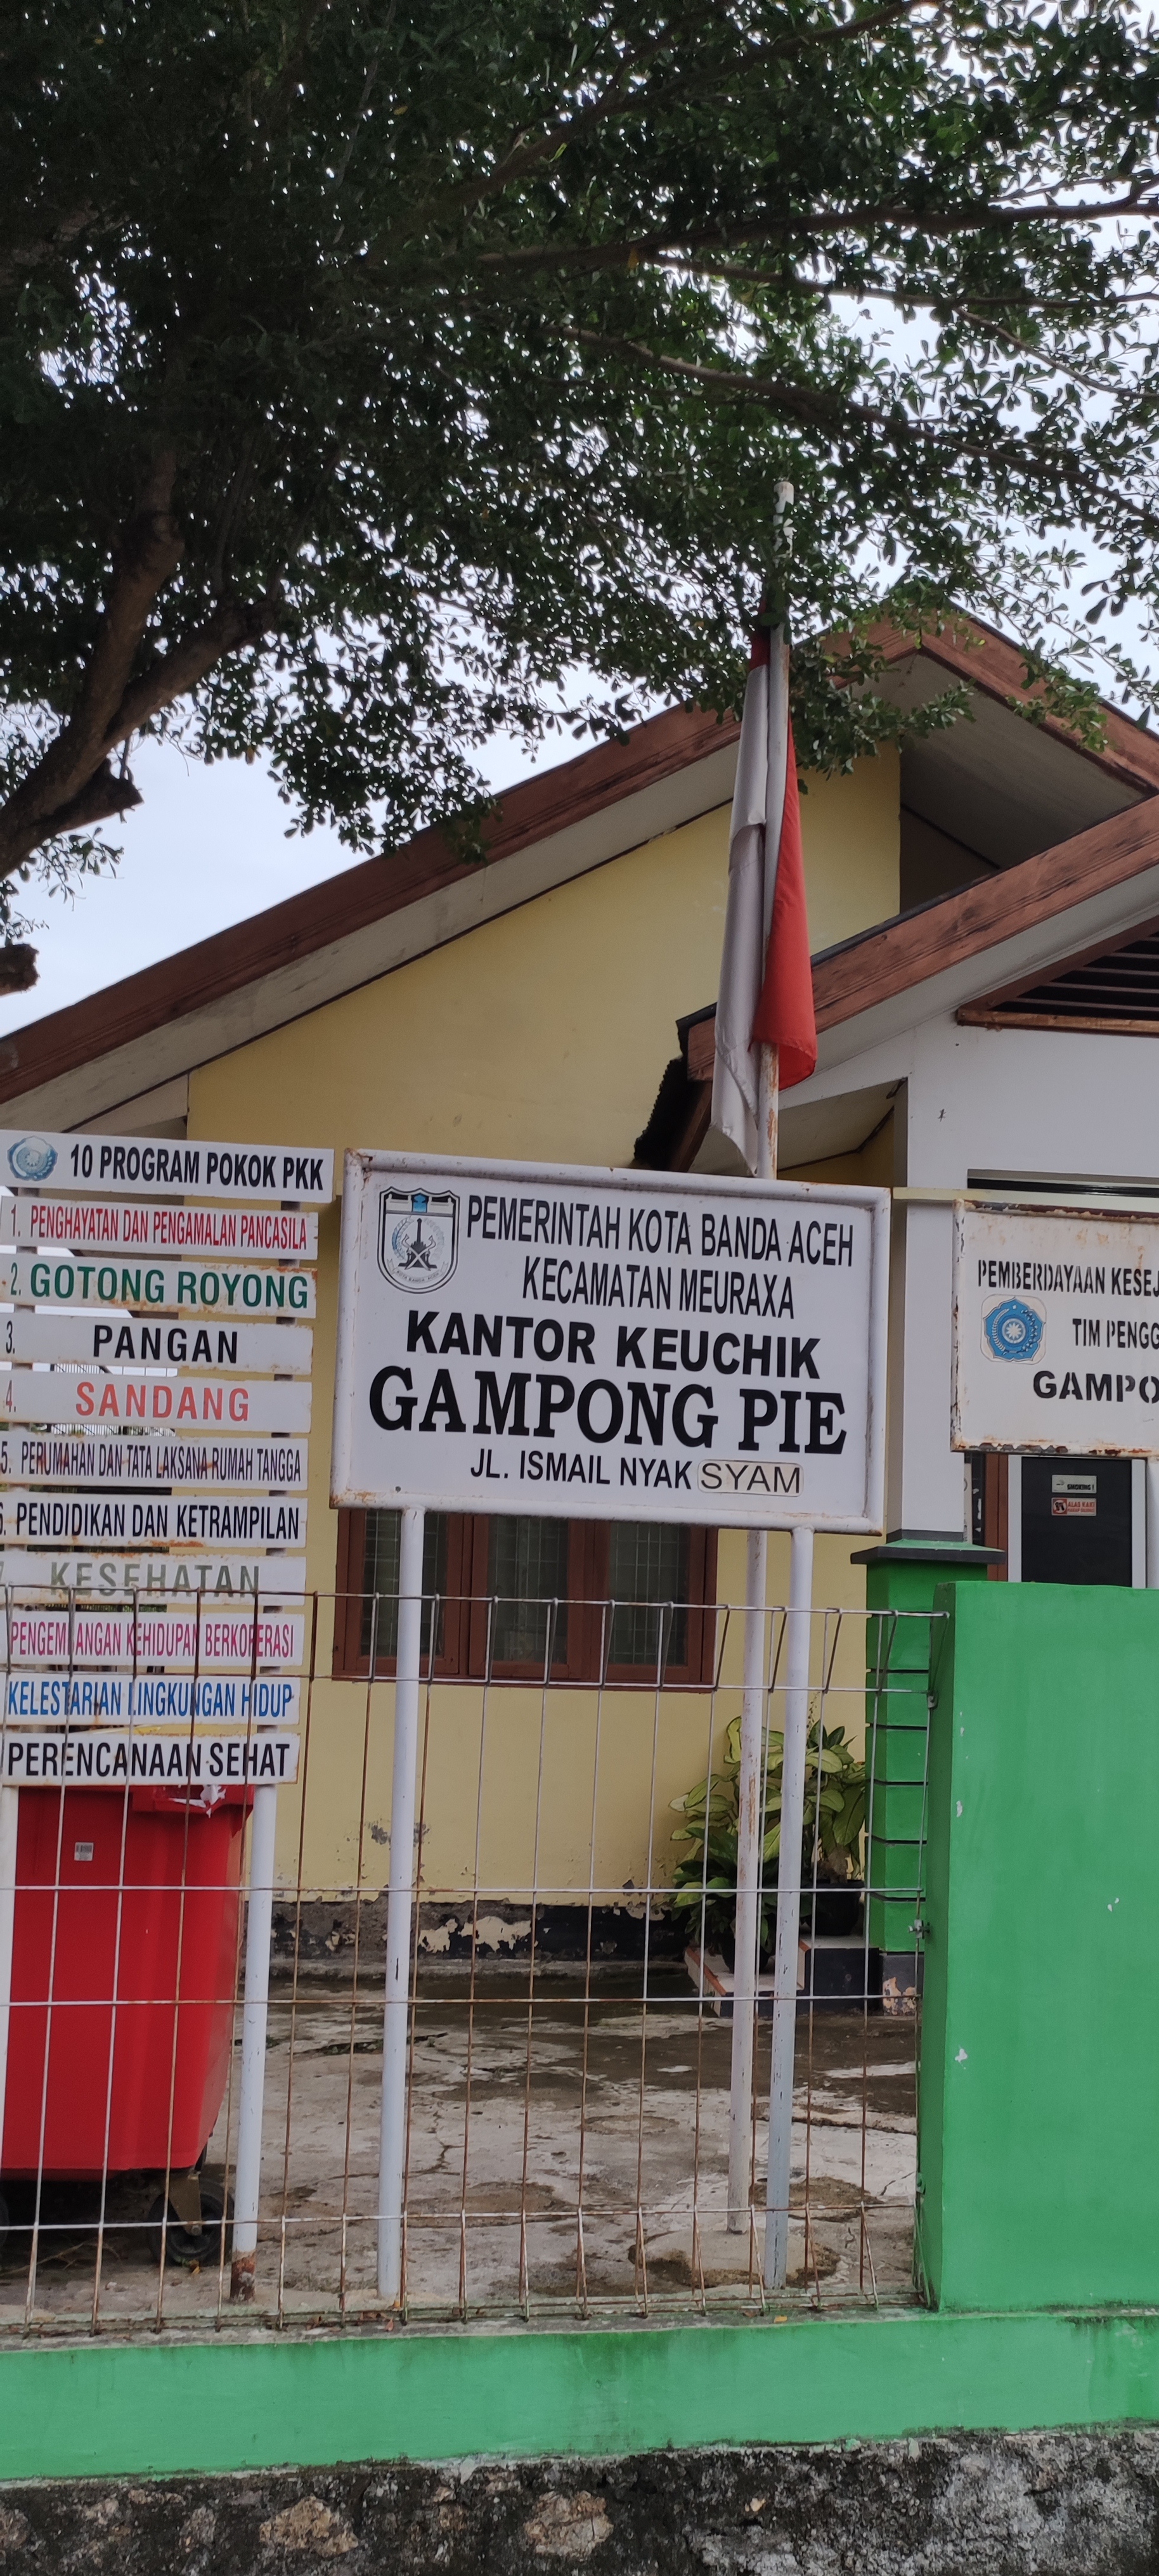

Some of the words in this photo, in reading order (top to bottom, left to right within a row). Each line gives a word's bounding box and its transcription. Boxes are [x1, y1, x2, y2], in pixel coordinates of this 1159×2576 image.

[70, 1143, 93, 1178] 10
[100, 1145, 200, 1183] PROGRAM
[206, 1152, 276, 1188] POKOK
[282, 1157, 324, 1190] PKK
[11, 1204, 21, 1237] 1.
[30, 1205, 119, 1242] PENGHAYATAN
[123, 1209, 148, 1243] DAN
[153, 1211, 236, 1247] PENGAMALAN
[240, 1214, 307, 1250] PANCASILA
[467, 1194, 621, 1251] PEMERINTAH
[628, 1208, 692, 1255] KOTA
[701, 1213, 782, 1261] BANDA
[788, 1220, 854, 1267] ACEH
[10, 1262, 22, 1296] 2.
[30, 1263, 165, 1303] GOTONG
[177, 1272, 308, 1308] ROYONG
[522, 1256, 671, 1311] KECAMATAN
[679, 1268, 794, 1319] MEURAXA
[978, 1259, 1105, 1294] PEMBERDAYAAN
[5, 1320, 15, 1354] 3.
[93, 1324, 238, 1364] PANGAN
[406, 1310, 596, 1365] KANTOR
[616, 1325, 821, 1380] KEUCHIK
[1072, 1318, 1101, 1347] TIM
[5, 1380, 16, 1412] 4.
[75, 1381, 249, 1422] SANDANG
[368, 1365, 718, 1448] GAMPONG
[737, 1389, 847, 1455] PIE
[21, 1441, 95, 1476] PERUMAHAN
[99, 1444, 122, 1478] DAN
[127, 1445, 152, 1478] TATA
[156, 1446, 208, 1480] LAKSANA
[212, 1447, 253, 1481] RUMAH
[257, 1448, 301, 1483] TANGGA
[470, 1448, 508, 1479] JL.
[519, 1452, 611, 1486] ISMAIL
[620, 1458, 692, 1490] NYAK
[700, 1462, 800, 1494] SYAM
[16, 1502, 125, 1537] PENDIDIKAN
[132, 1504, 168, 1537] DAN
[177, 1505, 299, 1540] KETRAMPILAN
[50, 1561, 259, 1598] KESEHATAN
[11, 1621, 121, 1656] PENGEMANGAN
[8, 1681, 121, 1716] KELESTARIAN
[241, 1683, 292, 1718] HIDUP
[8, 1742, 202, 1777] PERENCANAAN
[209, 1742, 290, 1777] SEHAT
